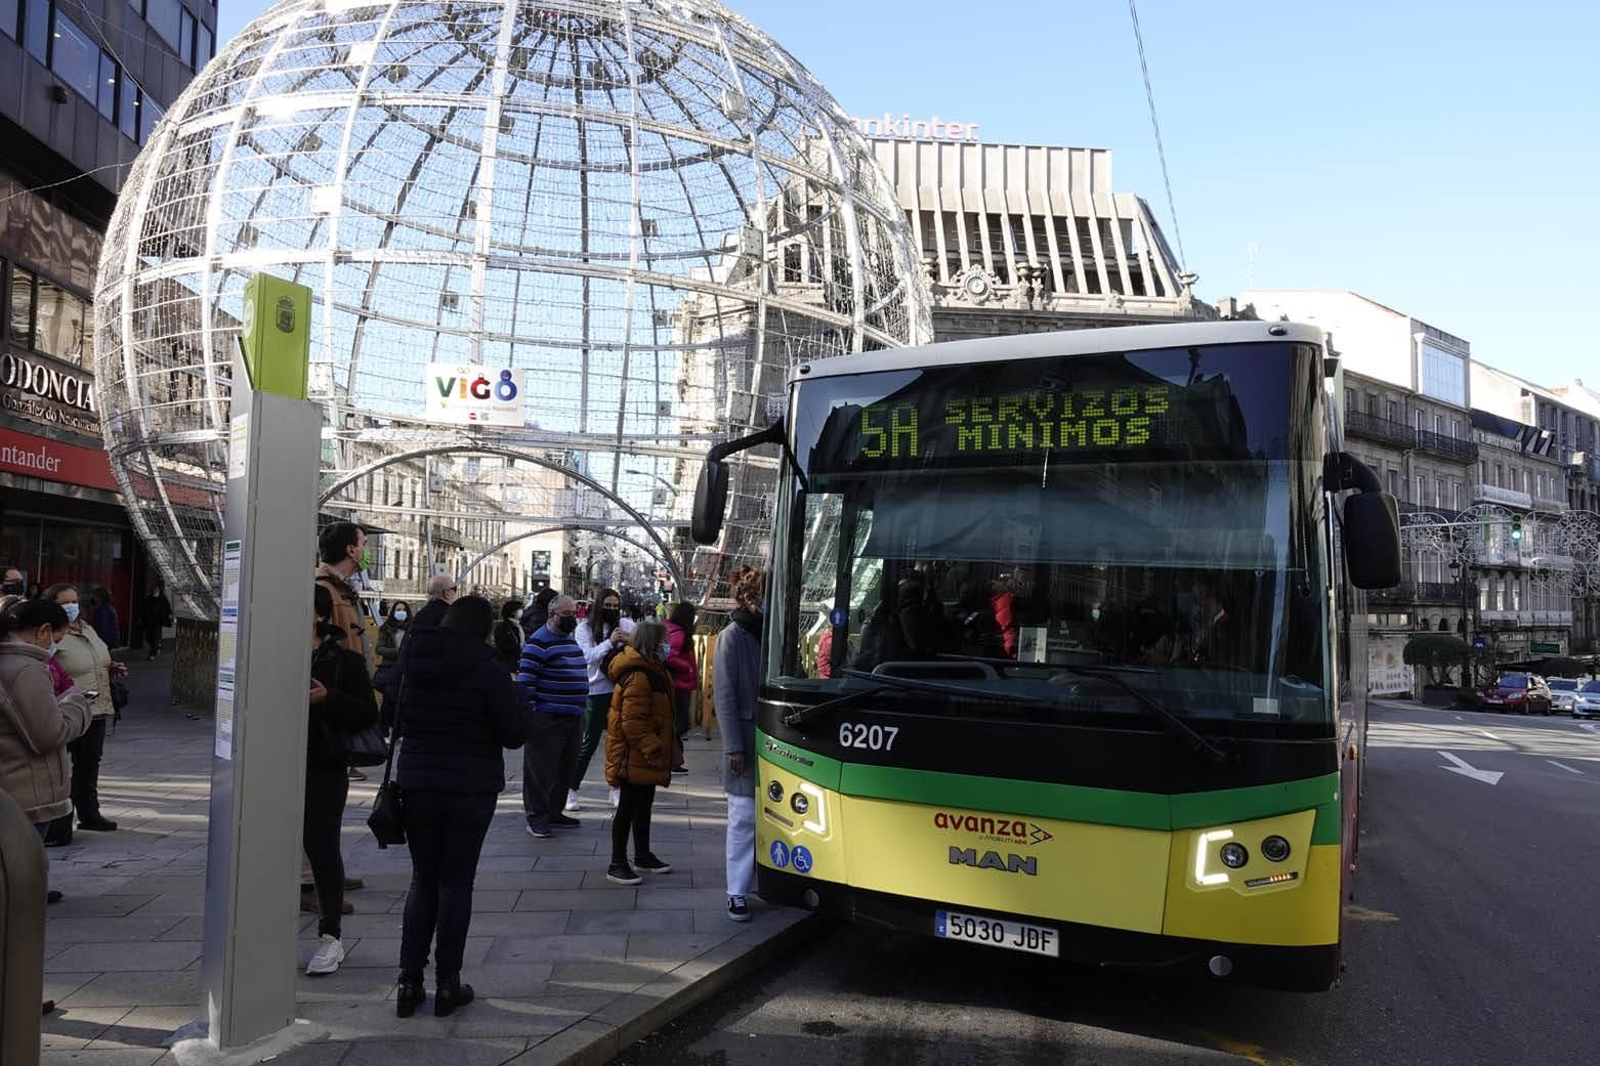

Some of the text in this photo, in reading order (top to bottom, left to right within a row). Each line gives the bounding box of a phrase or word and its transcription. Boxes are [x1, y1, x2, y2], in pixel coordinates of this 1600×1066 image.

[945, 386, 1169, 424] SERVIZOS
[861, 403, 919, 457] 5A
[957, 417, 1151, 451] MINIMOS
[1, 446, 62, 472] ntander
[839, 722, 899, 751] 6207
[934, 812, 1028, 838] avanza
[948, 846, 1038, 876] MAN
[950, 915, 1005, 943] 5030
[1013, 926, 1054, 952] JDF
